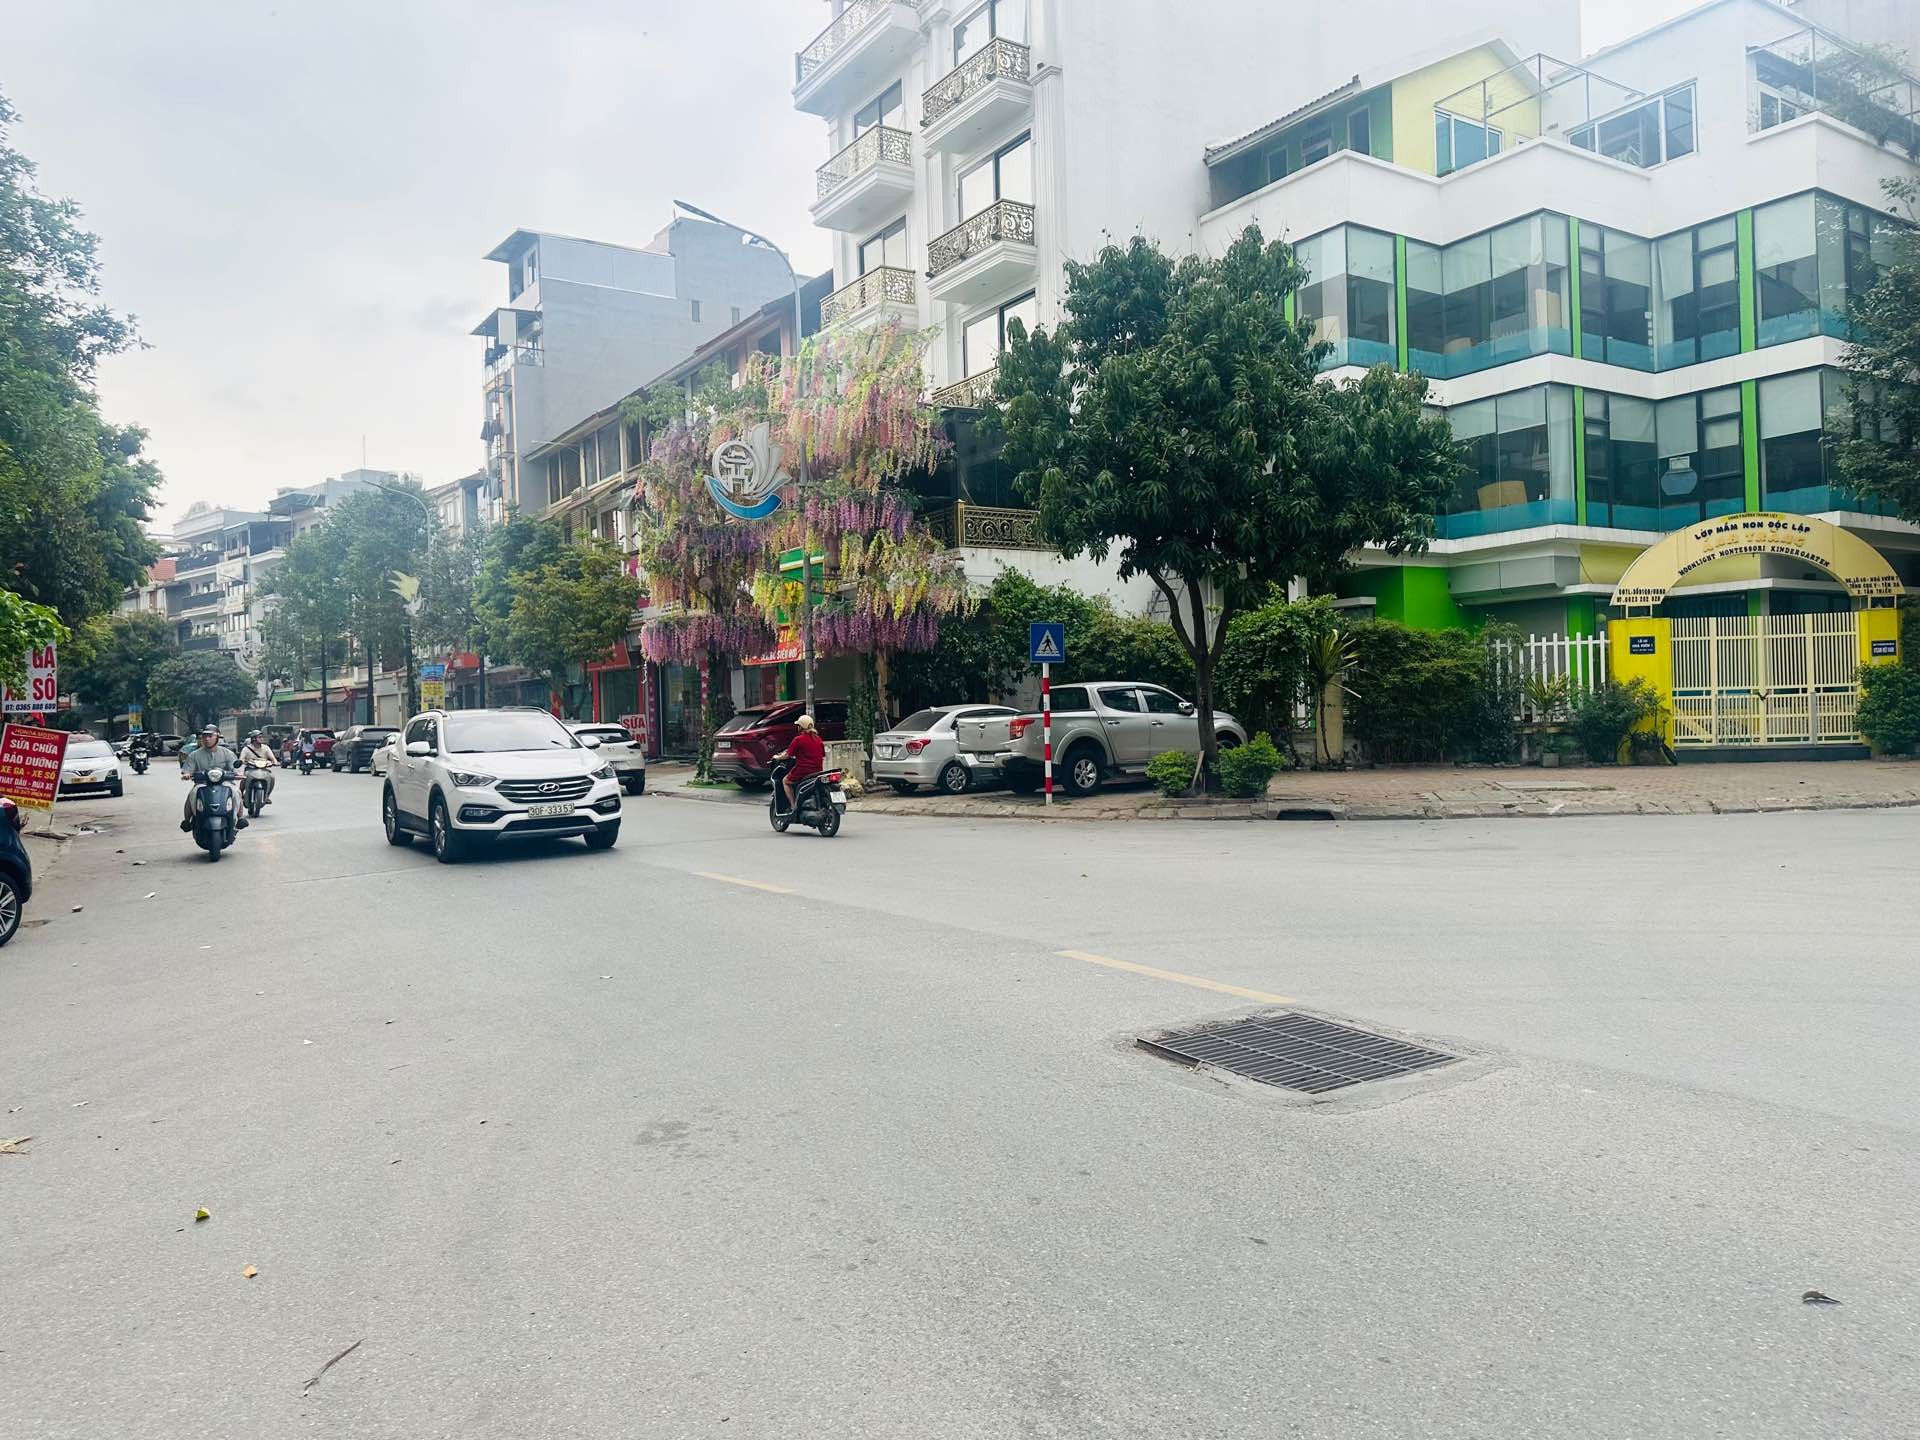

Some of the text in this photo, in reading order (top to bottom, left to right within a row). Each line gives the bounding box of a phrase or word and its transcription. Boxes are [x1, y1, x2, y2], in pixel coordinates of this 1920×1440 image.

[1695, 521, 1811, 540] LỚP MẦM NON ĐỘC LẬP
[1678, 545, 1830, 576] MOONLIGHT MONTESSORI KINDERGARTEN
[32, 645, 56, 668] GA
[32, 670, 56, 700] SỐ
[10, 737, 58, 754] SỬA CHỮA
[3, 752, 59, 769] BẢO DƯỠNG
[0, 765, 12, 774] XE
[13, 767, 25, 775] GA
[32, 769, 43, 778] XE
[44, 770, 57, 780] SỐ
[45, 782, 54, 791] XE
